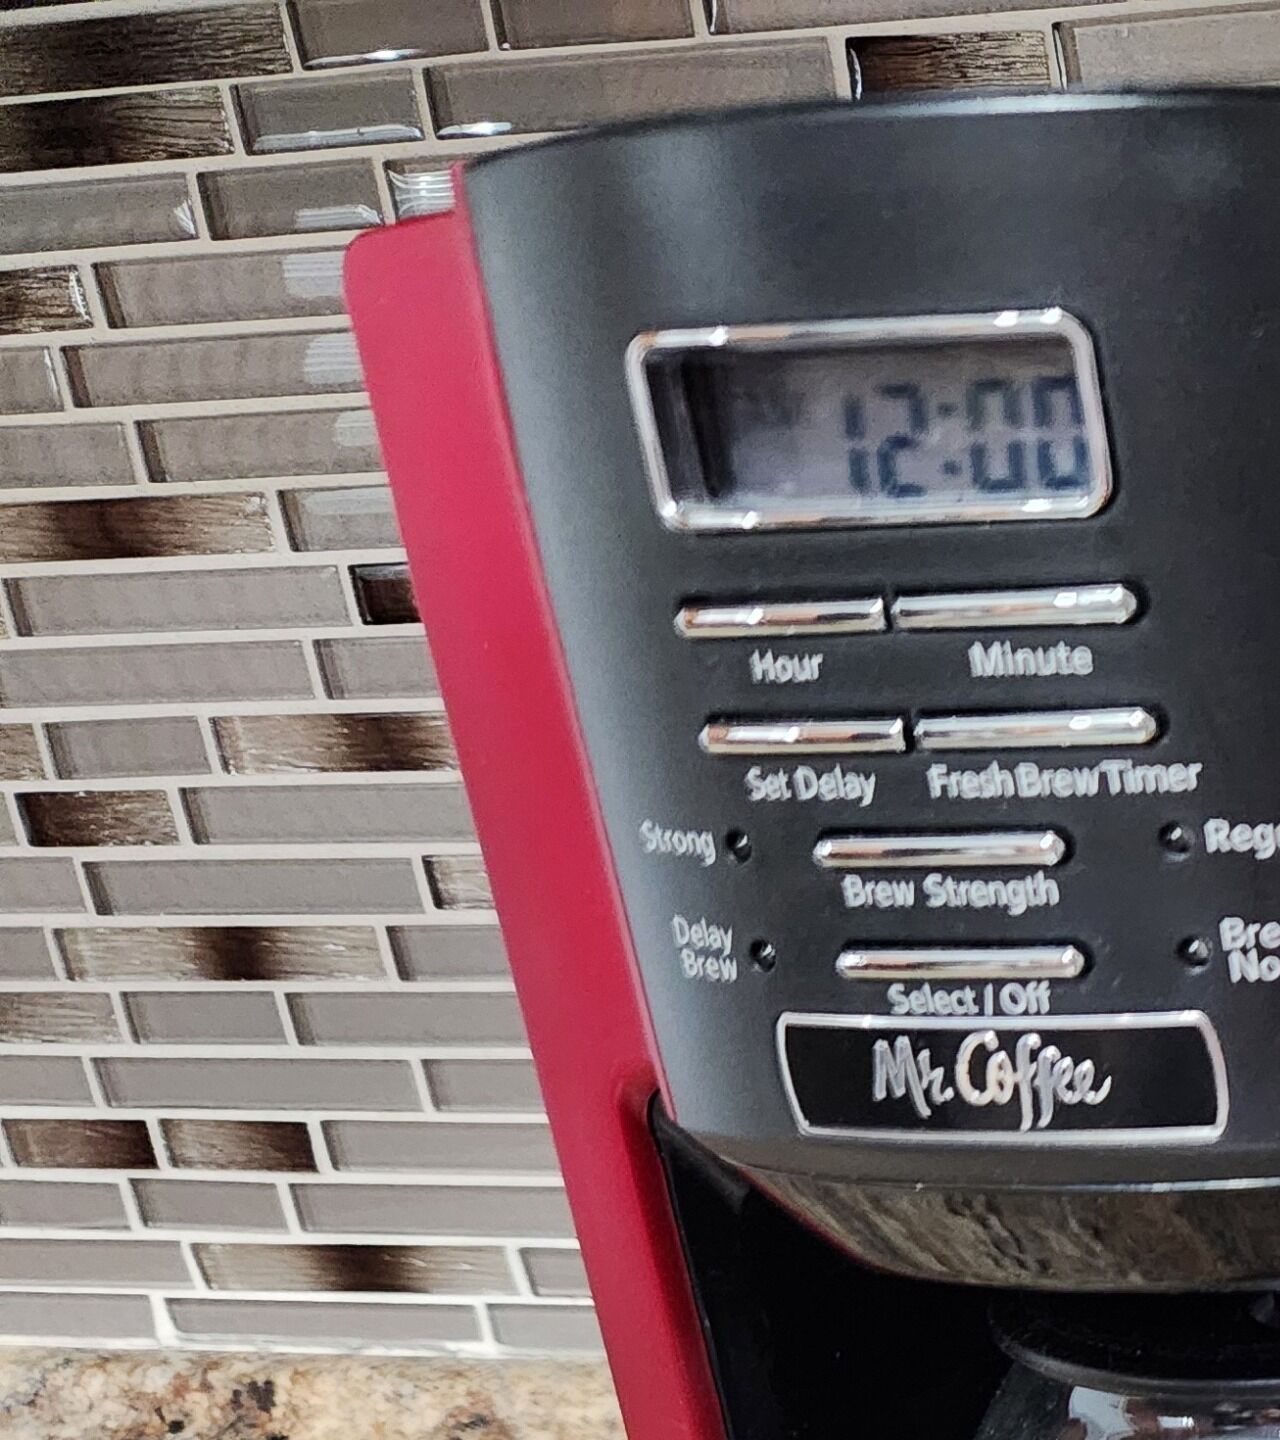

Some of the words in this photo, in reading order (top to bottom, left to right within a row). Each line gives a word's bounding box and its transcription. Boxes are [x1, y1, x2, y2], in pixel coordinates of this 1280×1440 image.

[843, 375, 1093, 499] 12:00
[749, 647, 824, 684] Hour
[967, 640, 1094, 678] Minute
[744, 765, 791, 800] Set
[793, 763, 877, 807] Delay
[926, 761, 1015, 799] Fresh
[1016, 762, 1099, 798] Brew
[1099, 758, 1203, 796] Timer
[639, 818, 717, 867] Strong
[840, 873, 915, 908] Brew
[922, 870, 1060, 917] Strength
[672, 914, 733, 957] Delay
[680, 947, 738, 983] Brew
[887, 981, 979, 1016] Select
[999, 980, 1051, 1016] Off
[955, 1029, 1113, 1132] Coffee
